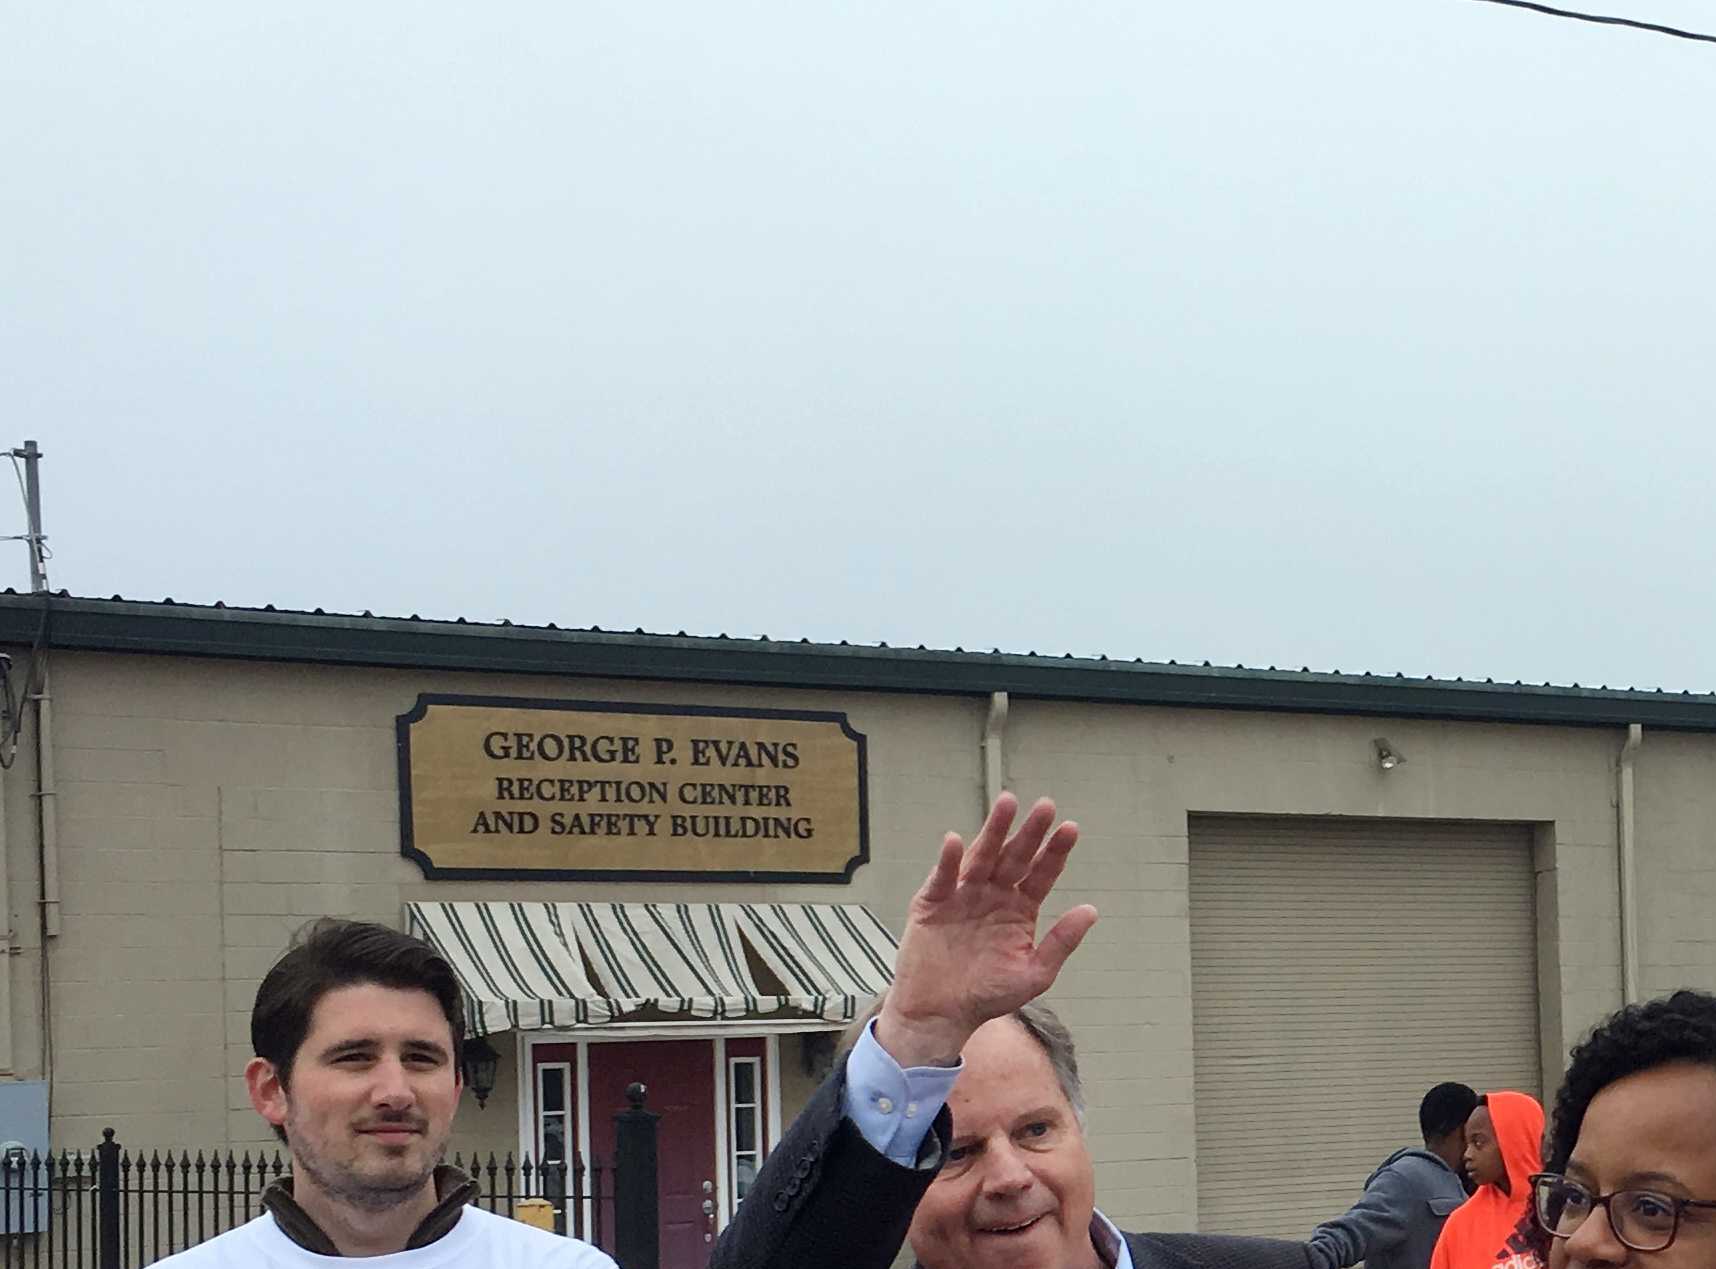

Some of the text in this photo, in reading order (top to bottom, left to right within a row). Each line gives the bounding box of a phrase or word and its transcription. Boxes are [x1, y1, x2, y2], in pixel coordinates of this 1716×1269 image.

[484, 732, 800, 770] GEORGE P. EVANS
[496, 777, 792, 807] RECEPTION CENTER
[470, 811, 815, 839] AND SAFETY BUILDING
